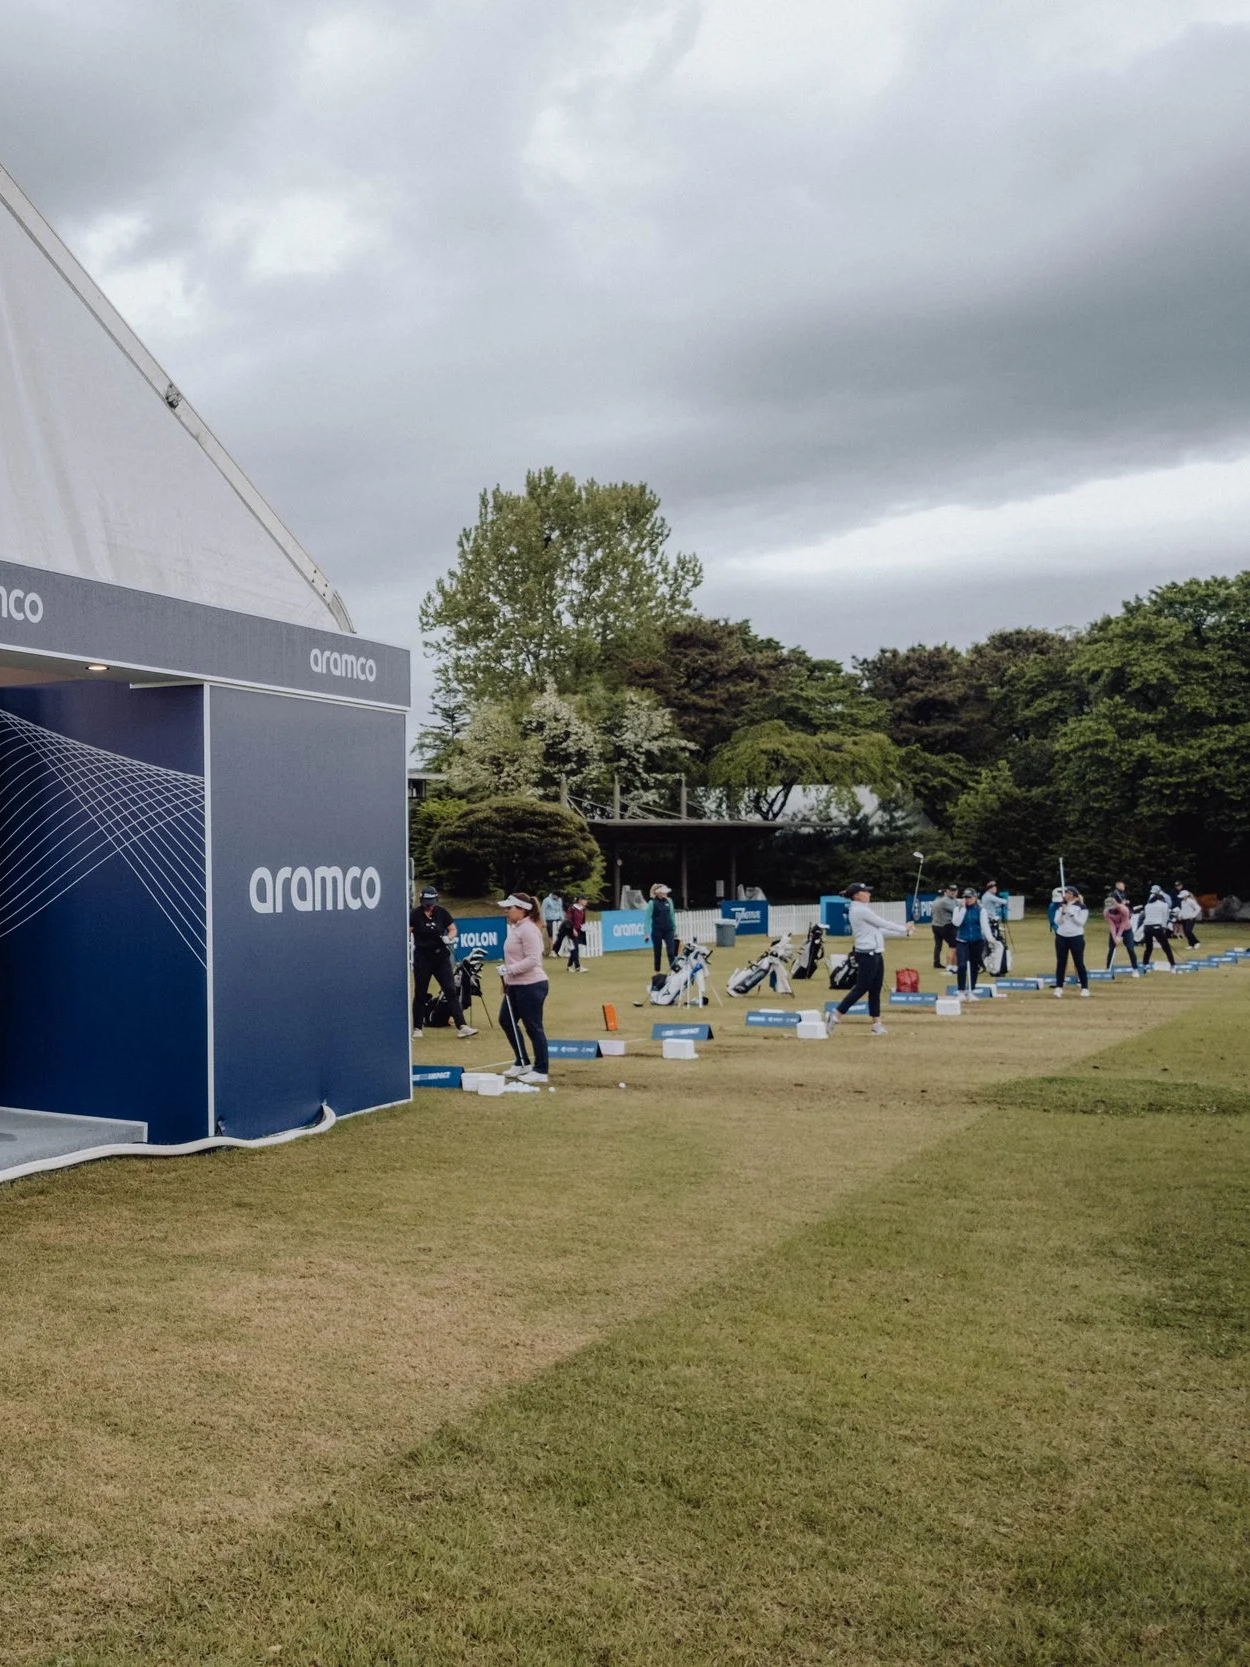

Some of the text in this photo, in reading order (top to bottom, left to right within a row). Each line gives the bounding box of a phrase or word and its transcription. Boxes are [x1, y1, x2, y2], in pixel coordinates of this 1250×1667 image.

[310, 648, 377, 682] aramco
[249, 866, 381, 914] aramco
[460, 932, 498, 948] KOLON
